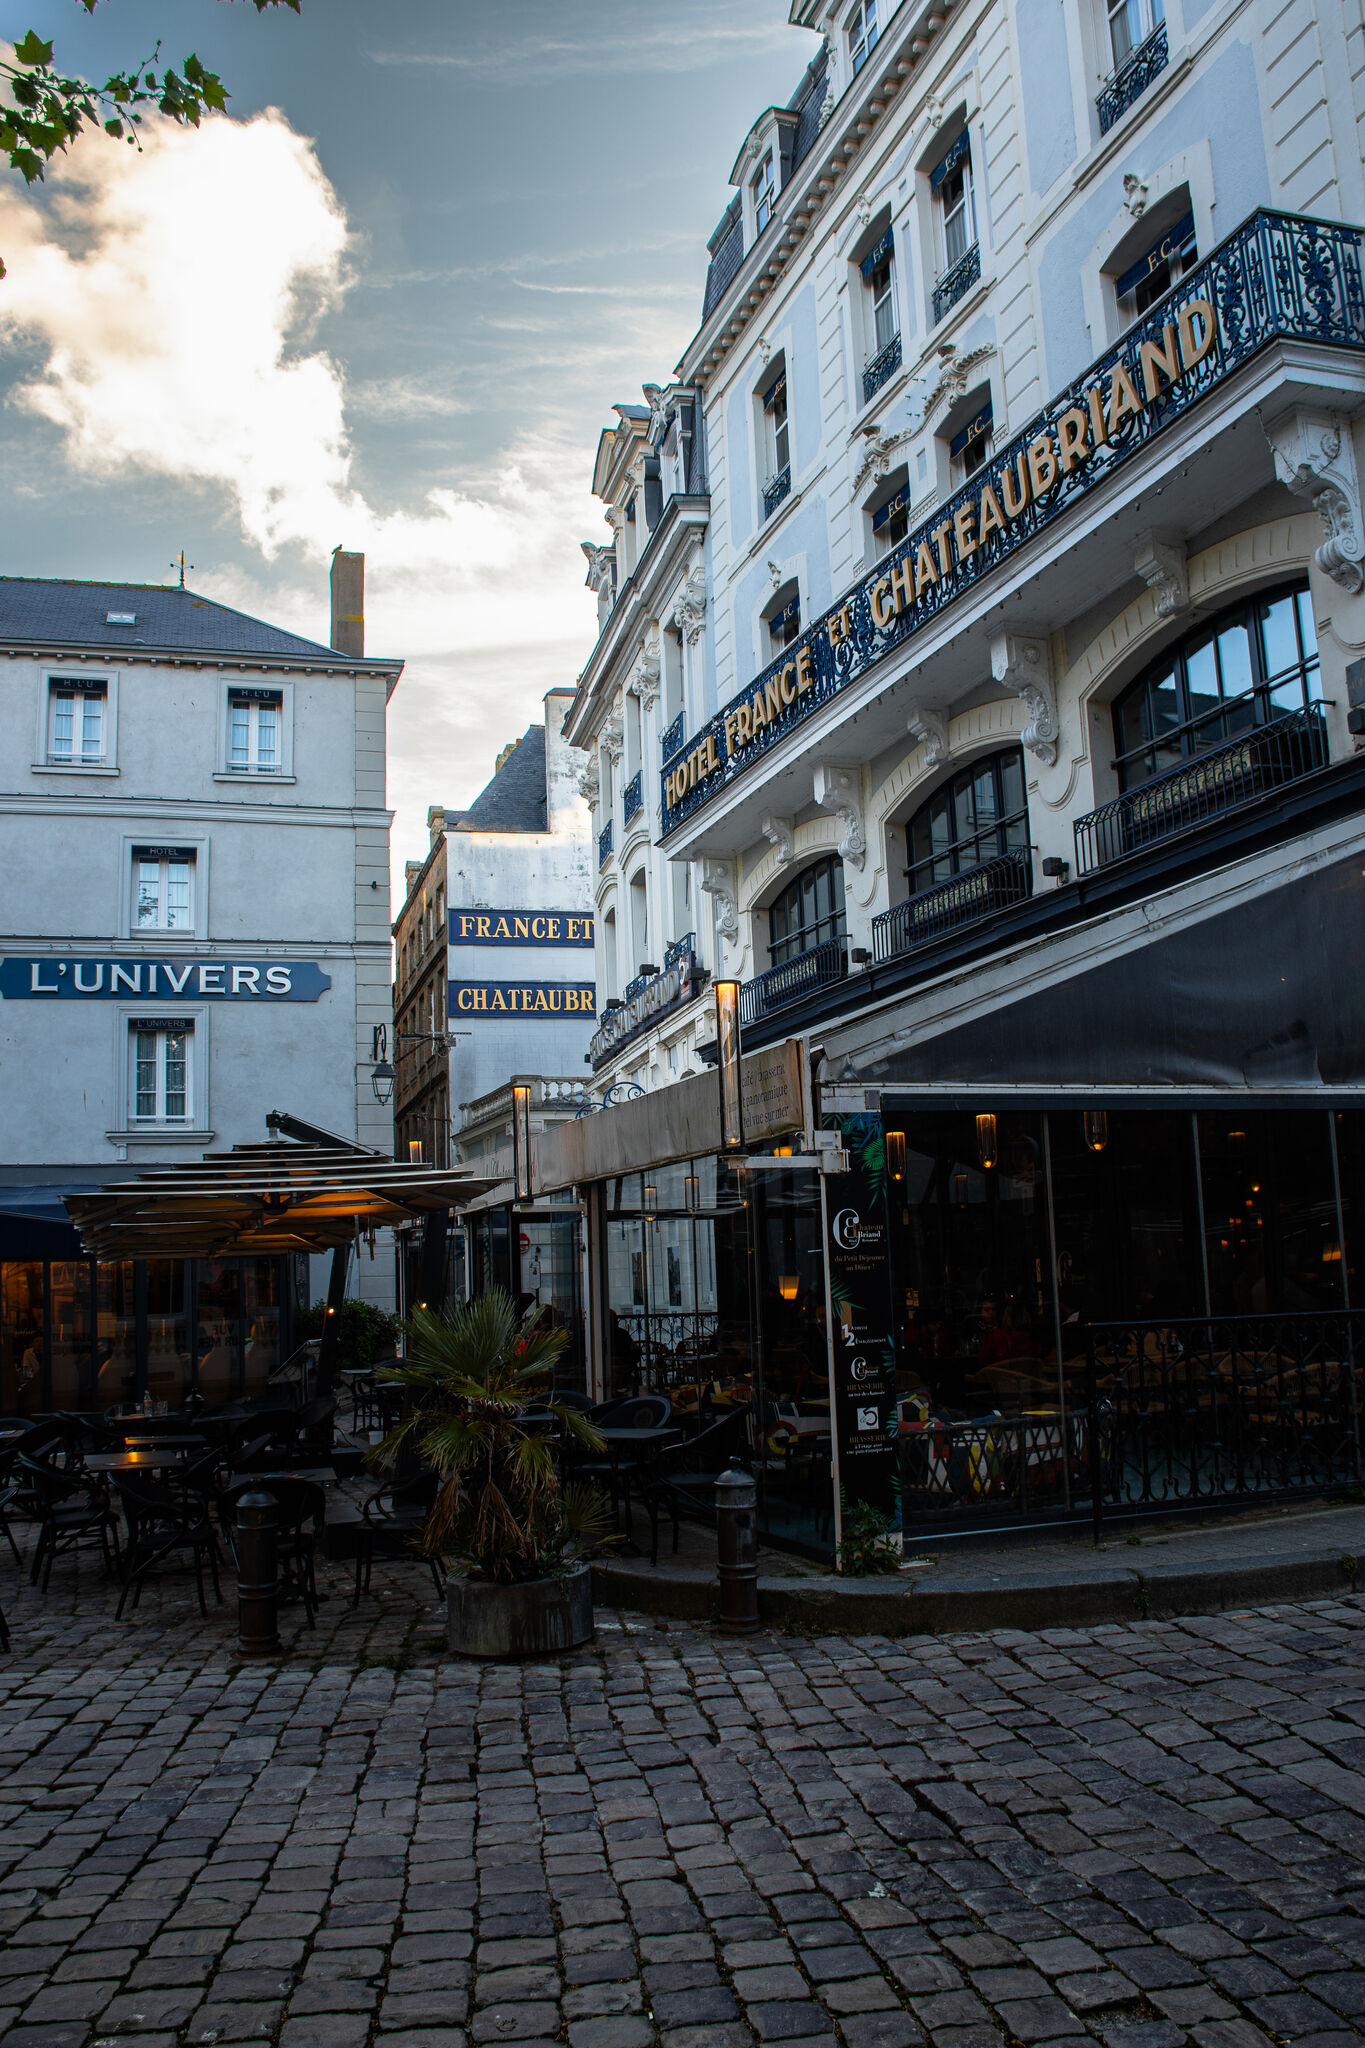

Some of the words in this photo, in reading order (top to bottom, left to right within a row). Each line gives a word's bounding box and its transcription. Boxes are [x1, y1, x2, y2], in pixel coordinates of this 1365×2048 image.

[666, 735, 720, 811] HOTEL
[724, 645, 813, 757] FRANCE
[827, 604, 851, 648] ET
[870, 299, 1217, 628] CHATEAUBRIAND
[149, 847, 179, 856] HOTEL
[459, 915, 561, 939] FRANCE
[566, 918, 594, 940] ET
[30, 962, 293, 996] L'UNIVERS
[457, 988, 597, 1011] CHATEAUBR
[746, 1085, 788, 1112] panoramique
[753, 1112, 764, 1126] vue
[764, 1110, 775, 1123] sur
[775, 1106, 789, 1119] mer
[844, 1331, 856, 1347] 2
